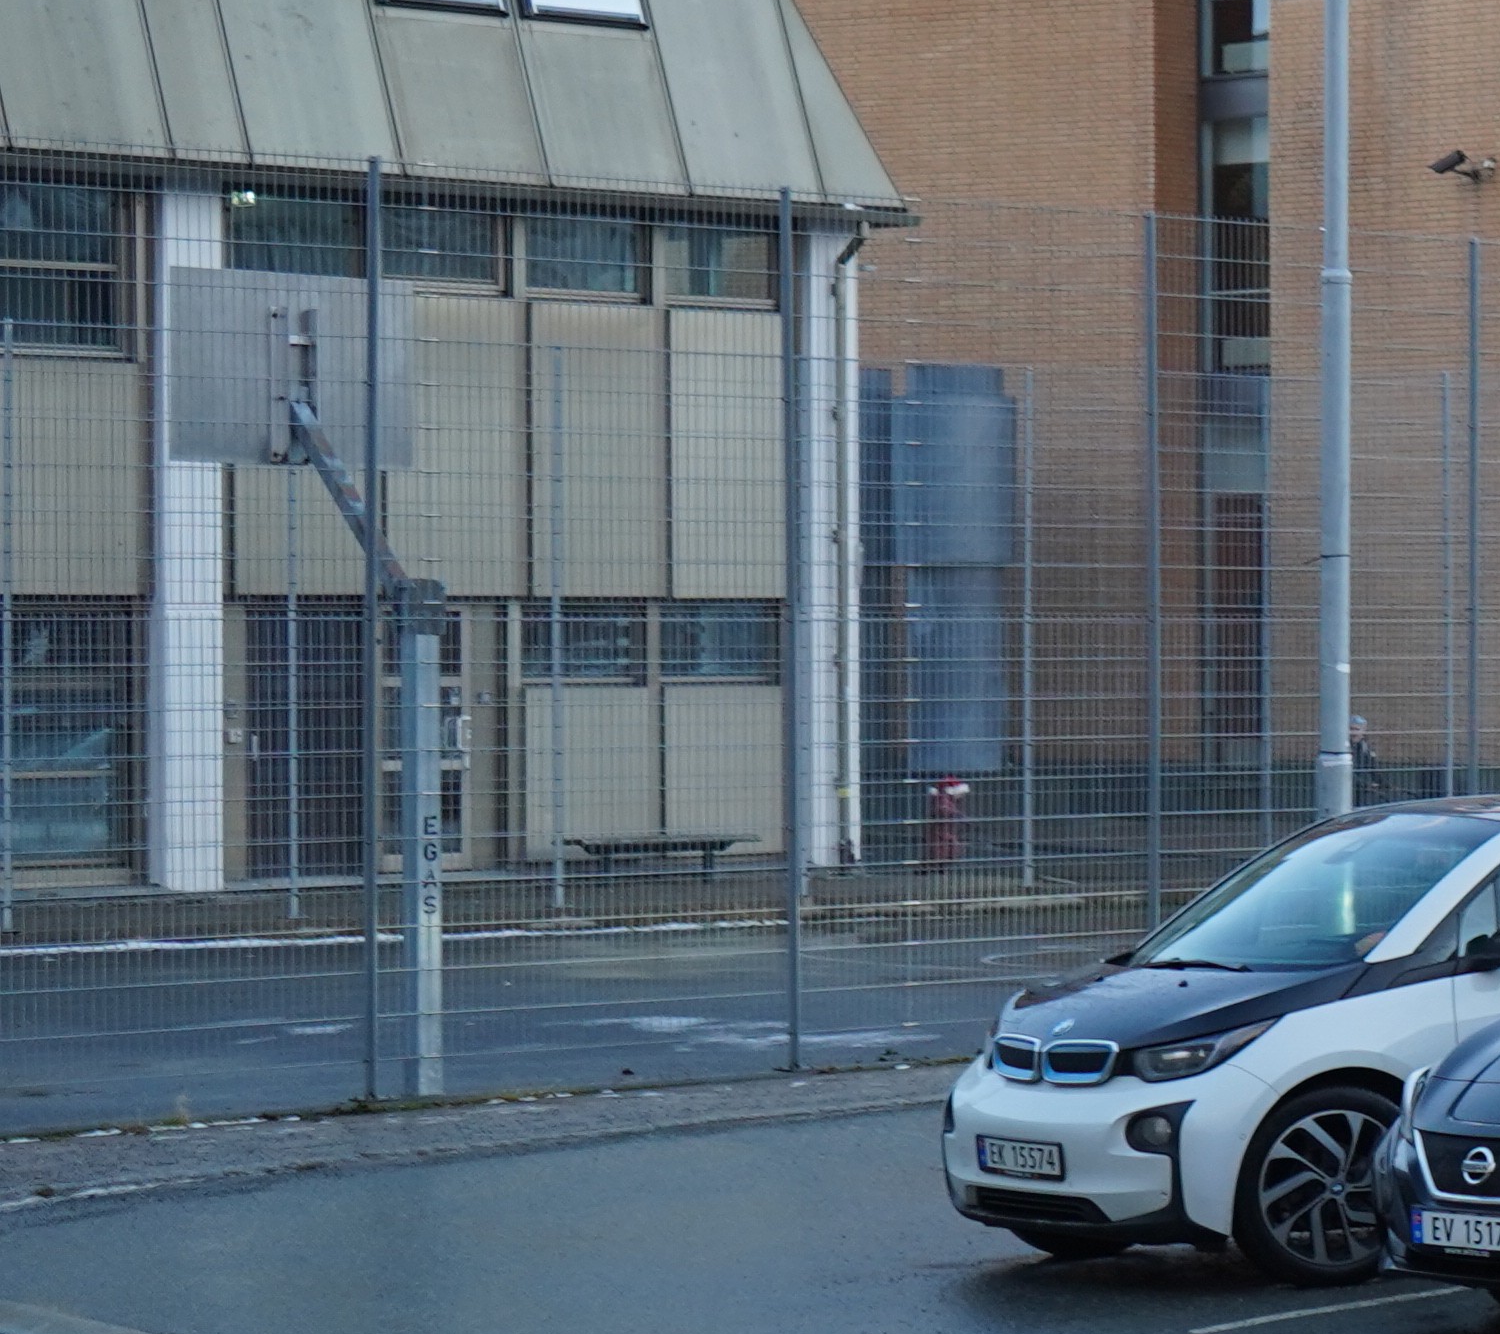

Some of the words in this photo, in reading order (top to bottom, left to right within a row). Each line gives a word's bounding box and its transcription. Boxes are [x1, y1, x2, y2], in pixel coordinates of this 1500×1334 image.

[988, 1142, 1007, 1167] EK
[1011, 1145, 1056, 1171] 15574
[1431, 1216, 1455, 1242] EV
